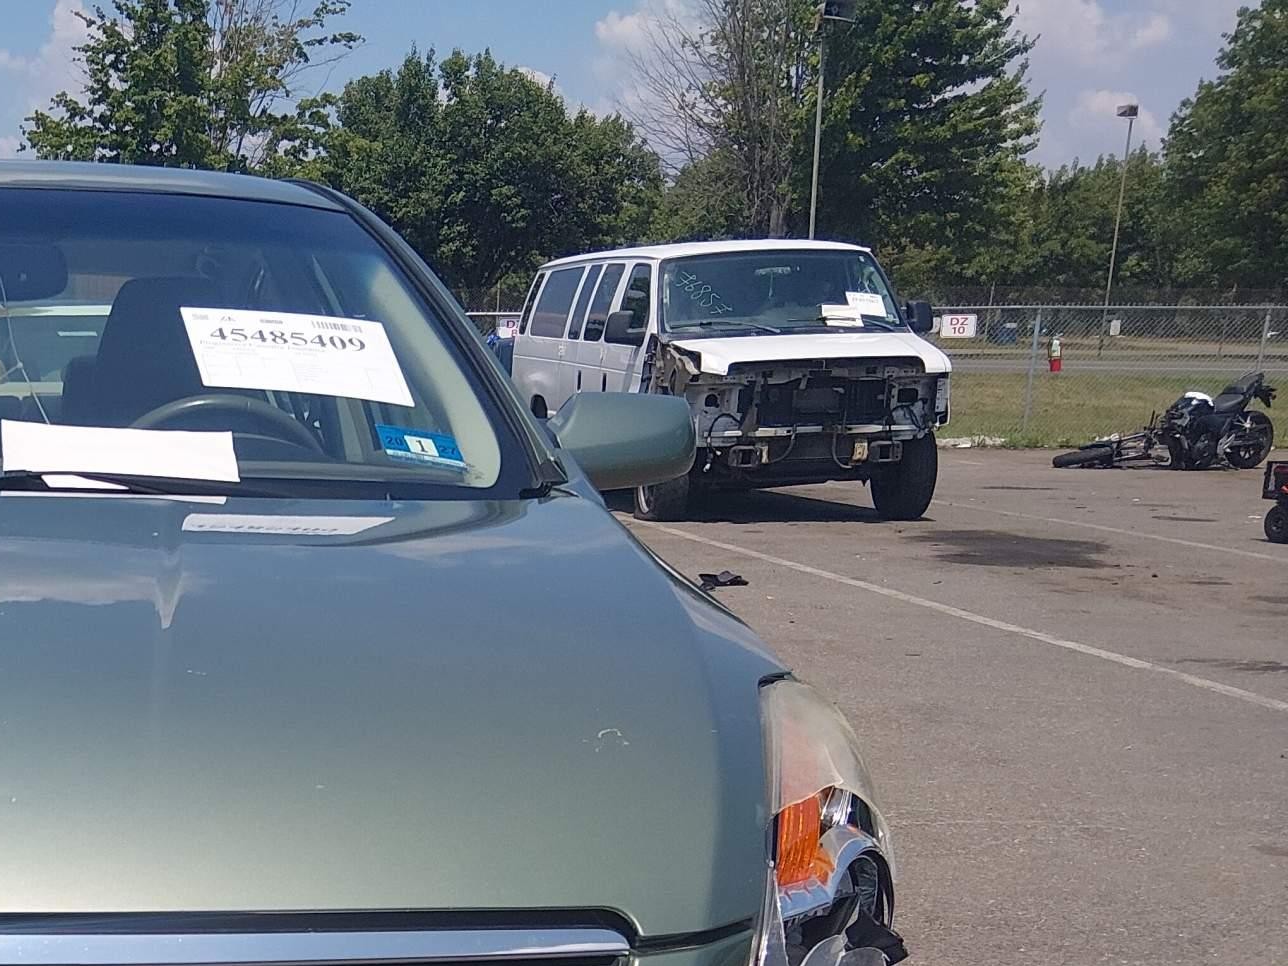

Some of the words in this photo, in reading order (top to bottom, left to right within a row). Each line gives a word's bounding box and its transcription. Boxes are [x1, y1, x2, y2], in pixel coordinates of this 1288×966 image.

[950, 317, 969, 326] DZ
[952, 326, 966, 335] 10
[210, 327, 366, 351] 45485409
[385, 436, 405, 446] 20
[416, 440, 429, 453] 1
